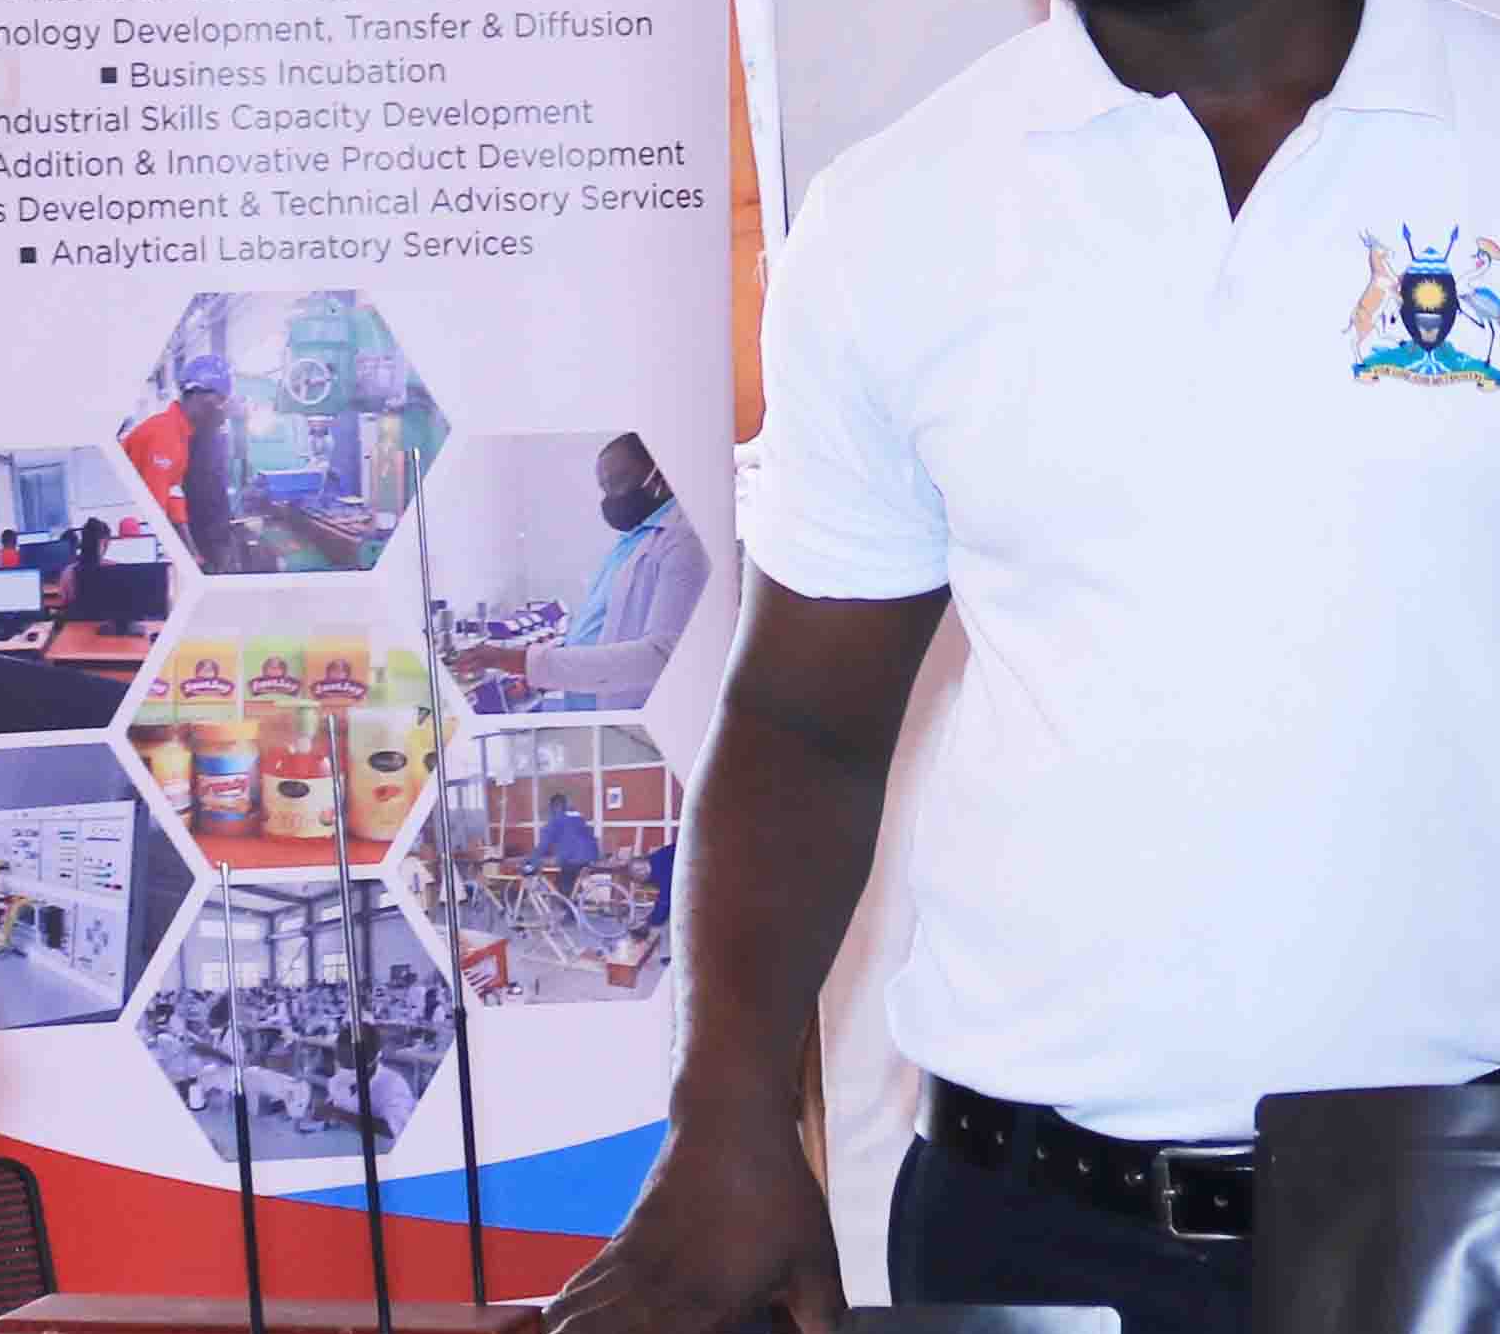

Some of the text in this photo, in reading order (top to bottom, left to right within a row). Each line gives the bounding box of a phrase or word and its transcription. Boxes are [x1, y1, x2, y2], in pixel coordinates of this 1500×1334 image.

[114, 17, 332, 47] Development,
[345, 12, 472, 40] Transfer
[482, 12, 503, 39] &
[515, 11, 652, 38] Diffusion
[131, 57, 445, 88] Business Incubation
[141, 105, 219, 131] Skills
[231, 102, 371, 133] Capacity
[383, 99, 593, 130] Development
[135, 149, 155, 175] &
[168, 149, 329, 175] Innovative
[343, 145, 467, 171] Product
[479, 141, 685, 170] Development
[18, 195, 228, 224] Development
[240, 191, 260, 217] &
[271, 187, 418, 216] Technical
[431, 187, 569, 216] Advisory
[582, 183, 705, 210] Services
[52, 230, 533, 269] Analytical Labaratory Services
